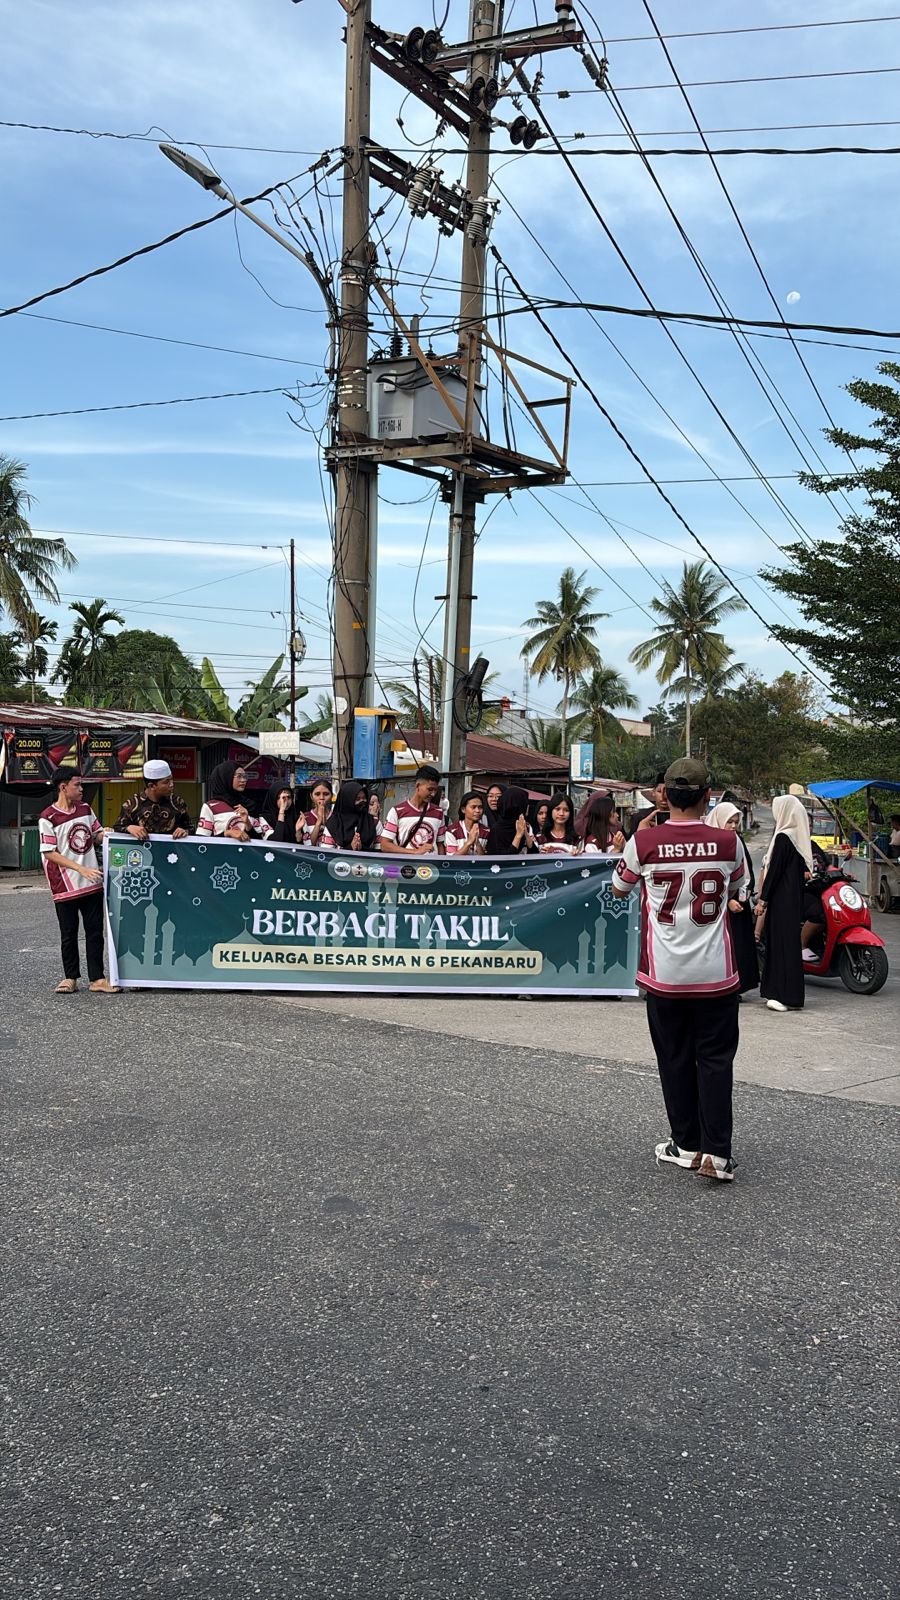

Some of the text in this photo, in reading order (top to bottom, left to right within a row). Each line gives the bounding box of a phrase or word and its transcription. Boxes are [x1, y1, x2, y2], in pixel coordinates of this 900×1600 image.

[657, 842, 718, 858] IRSYAD
[270, 887, 493, 907] MARHABAN YA RAMADHAN
[650, 868, 727, 928] 78
[252, 908, 509, 947] BERBAGI TAKJIL
[219, 950, 537, 969] KELUARGA BESAR SMA N 6 PEKANBARU
